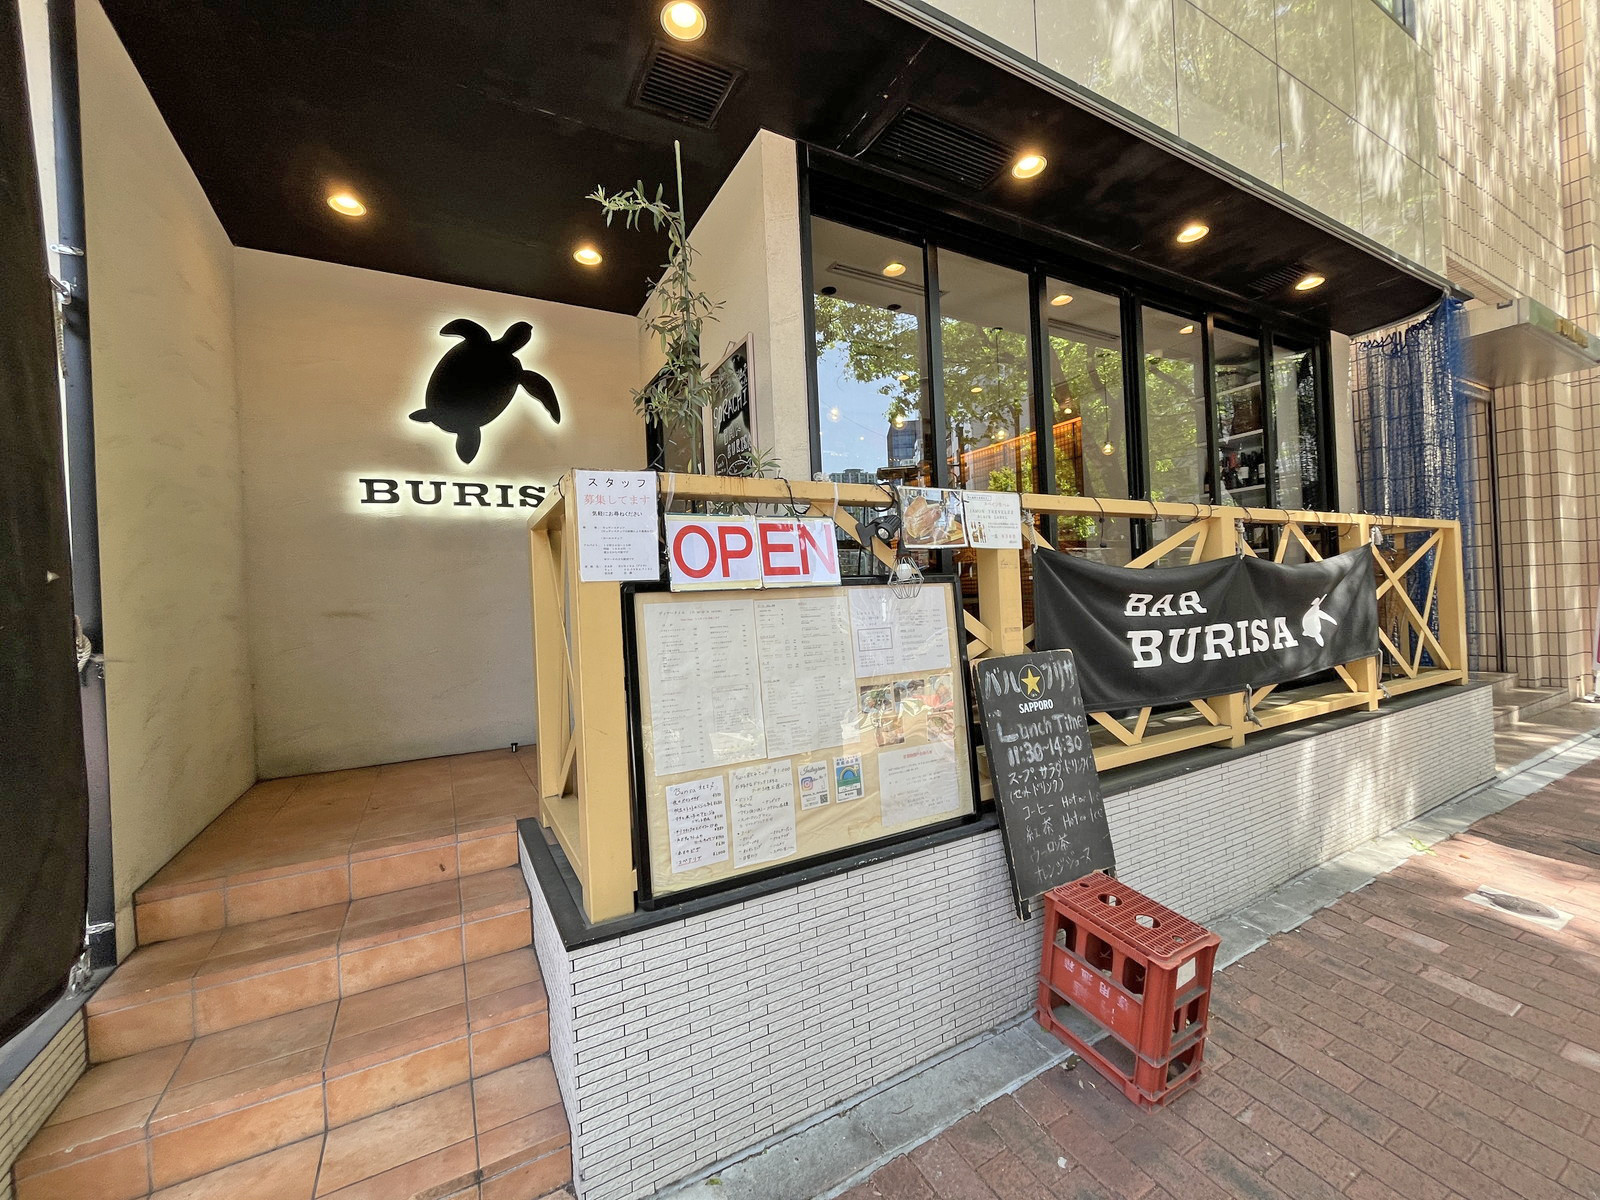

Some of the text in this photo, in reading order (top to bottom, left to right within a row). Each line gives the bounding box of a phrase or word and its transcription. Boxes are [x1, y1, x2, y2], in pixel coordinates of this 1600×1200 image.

[588, 478, 646, 488] スタッフ
[584, 494, 651, 506] 募集してます
[673, 523, 836, 578] OPEN
[1124, 591, 1207, 617] BAR
[1127, 617, 1298, 669] BURISA
[1018, 699, 1054, 714] SAPPORO
[996, 713, 1084, 743] Lunch Time
[1062, 792, 1077, 808] Hot
[1062, 810, 1079, 830] Hot
